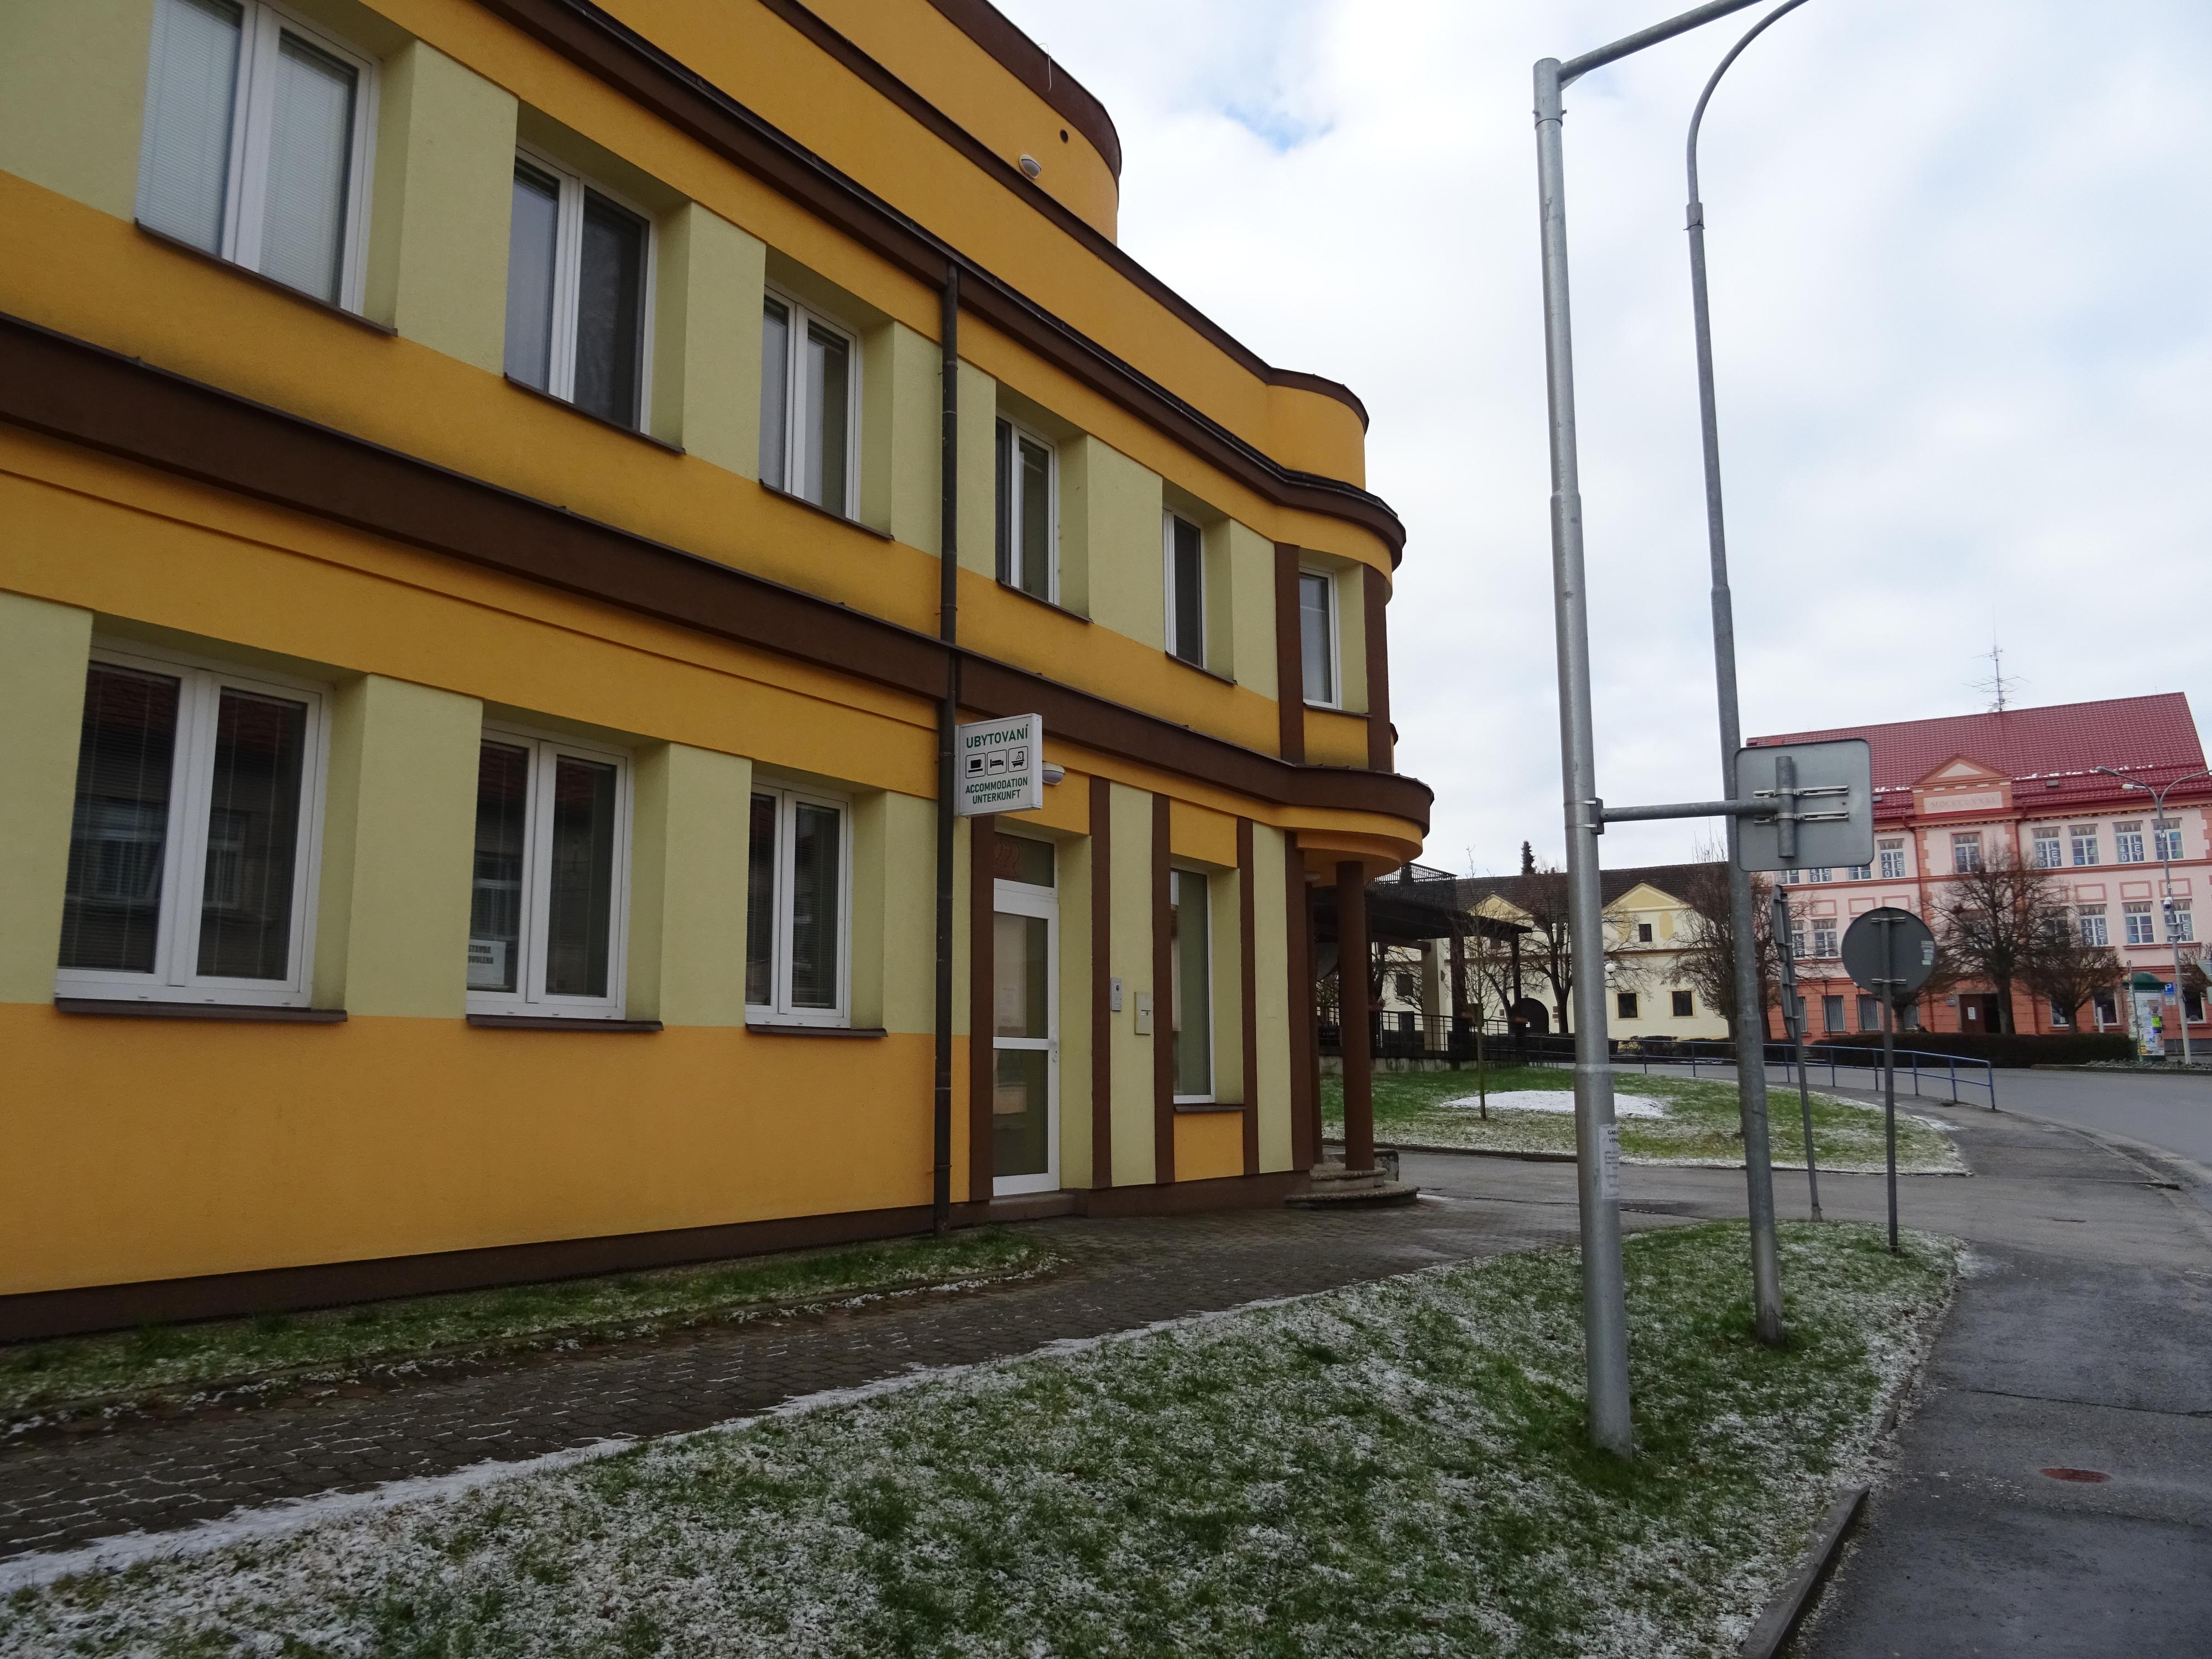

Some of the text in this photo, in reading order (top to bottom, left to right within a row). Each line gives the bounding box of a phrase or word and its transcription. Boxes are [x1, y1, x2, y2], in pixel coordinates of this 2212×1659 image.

[966, 724, 1029, 748] UBYTOVANÍ
[966, 777, 1028, 794] ACCOMMODATION
[973, 789, 1021, 804] UNTERKUNFT
[2164, 983, 2172, 992] P
